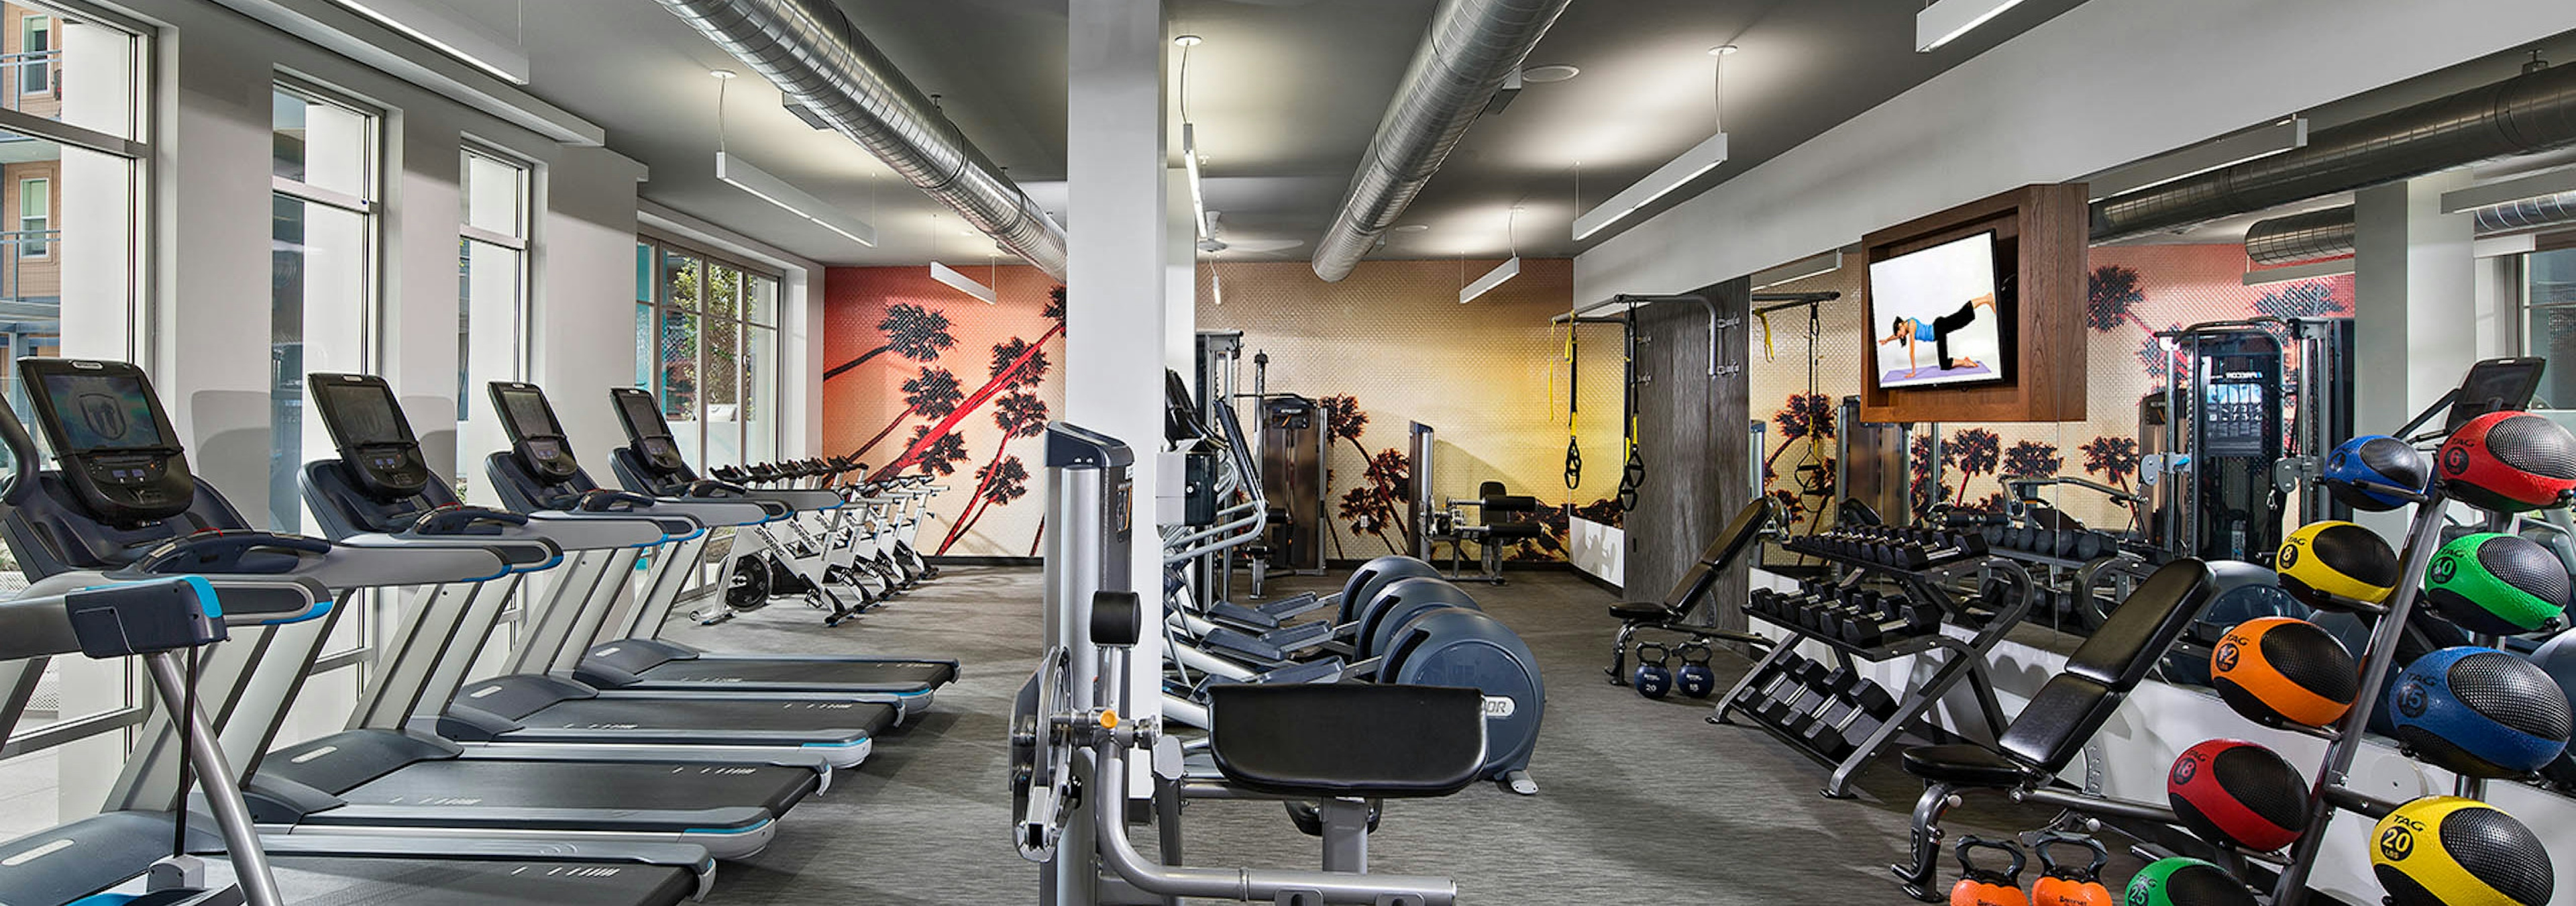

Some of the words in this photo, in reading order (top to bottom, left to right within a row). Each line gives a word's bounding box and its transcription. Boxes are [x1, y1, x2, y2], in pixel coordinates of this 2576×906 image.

[2452, 438, 2475, 447] TAG
[2449, 449, 2461, 466] 6
[2288, 536, 2306, 546] TAG
[2282, 546, 2293, 561] 8
[2440, 548, 2466, 558] TAG
[2434, 559, 2453, 575] 10
[2228, 634, 2250, 646] TAG
[2219, 645, 2237, 664] 12
[2407, 673, 2436, 686] TAG
[1646, 684, 1657, 692] 20
[2402, 686, 2424, 708] 15
[2176, 760, 2195, 777] 18
[2394, 814, 2426, 832] TAG
[2382, 828, 2411, 852] 20
[2129, 885, 2147, 905] 25
